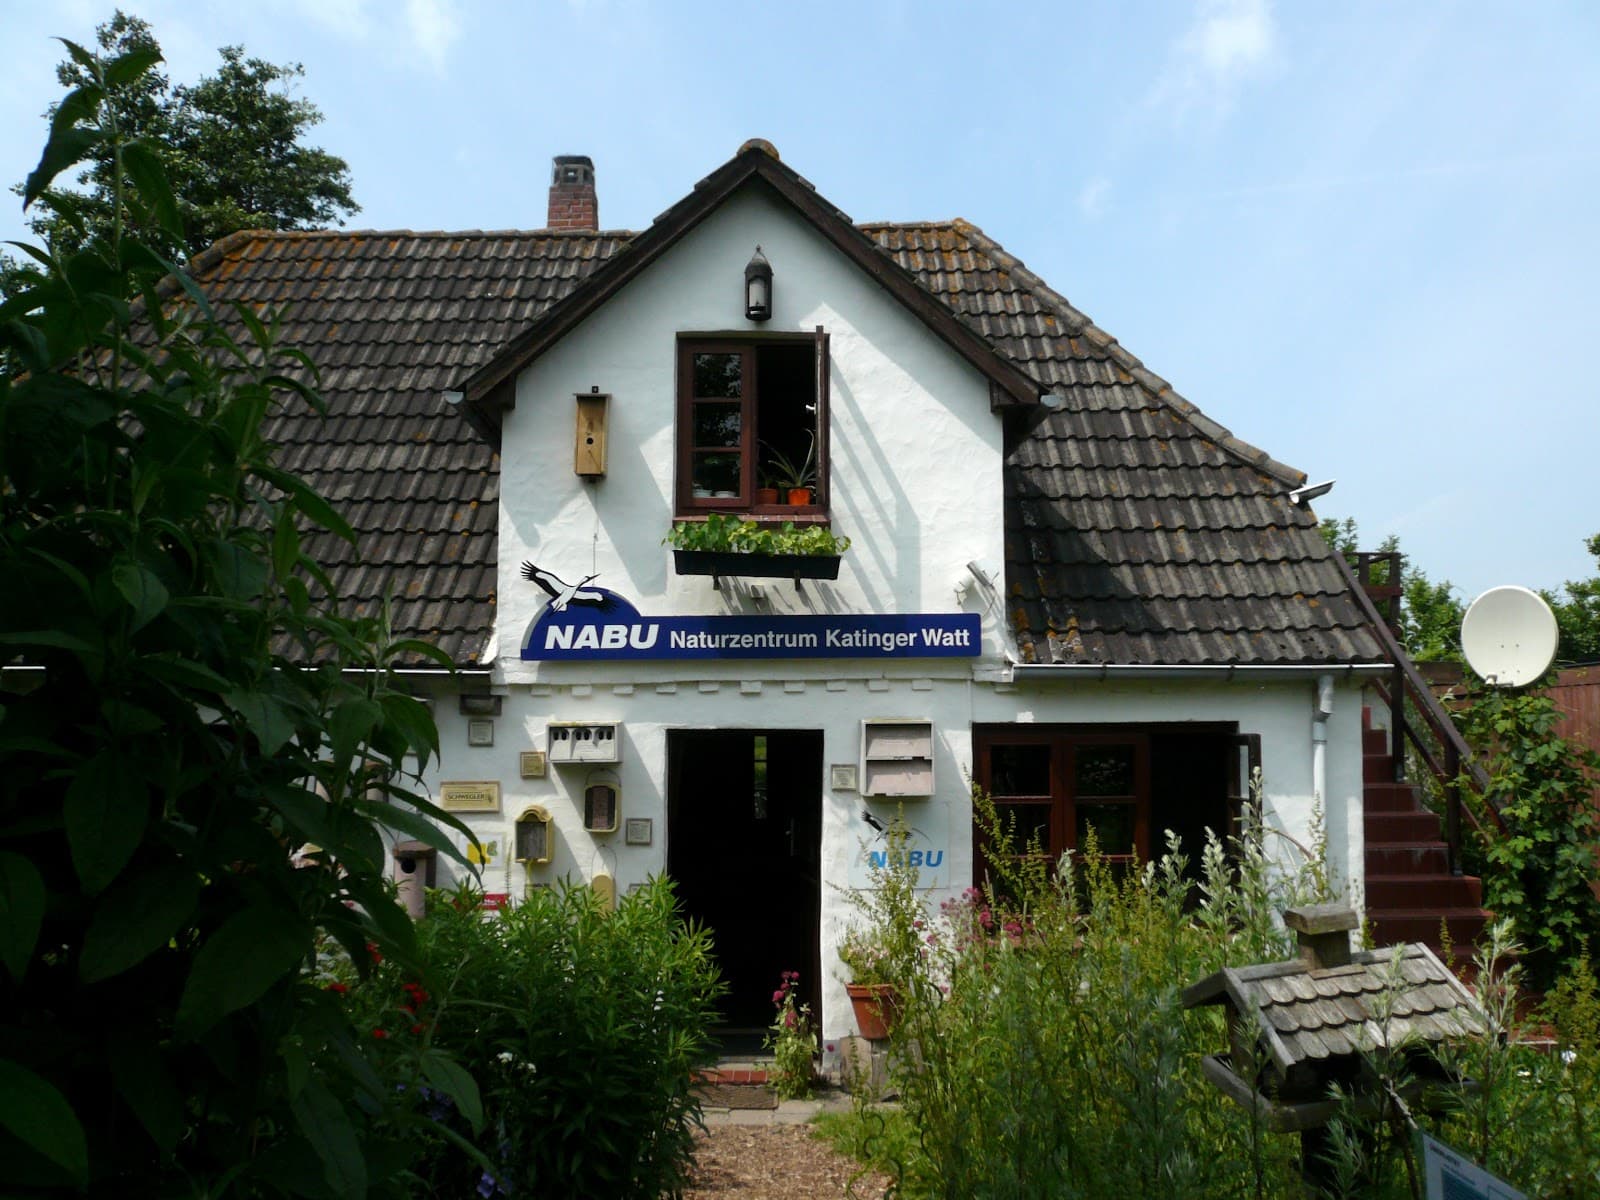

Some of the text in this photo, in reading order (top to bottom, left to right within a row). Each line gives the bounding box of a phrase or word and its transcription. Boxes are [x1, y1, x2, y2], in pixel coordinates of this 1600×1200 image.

[544, 624, 970, 651] NABU Naturzentrum Katinger Watt
[447, 792, 485, 800] SCHWEGLER
[868, 850, 944, 868] NBU
